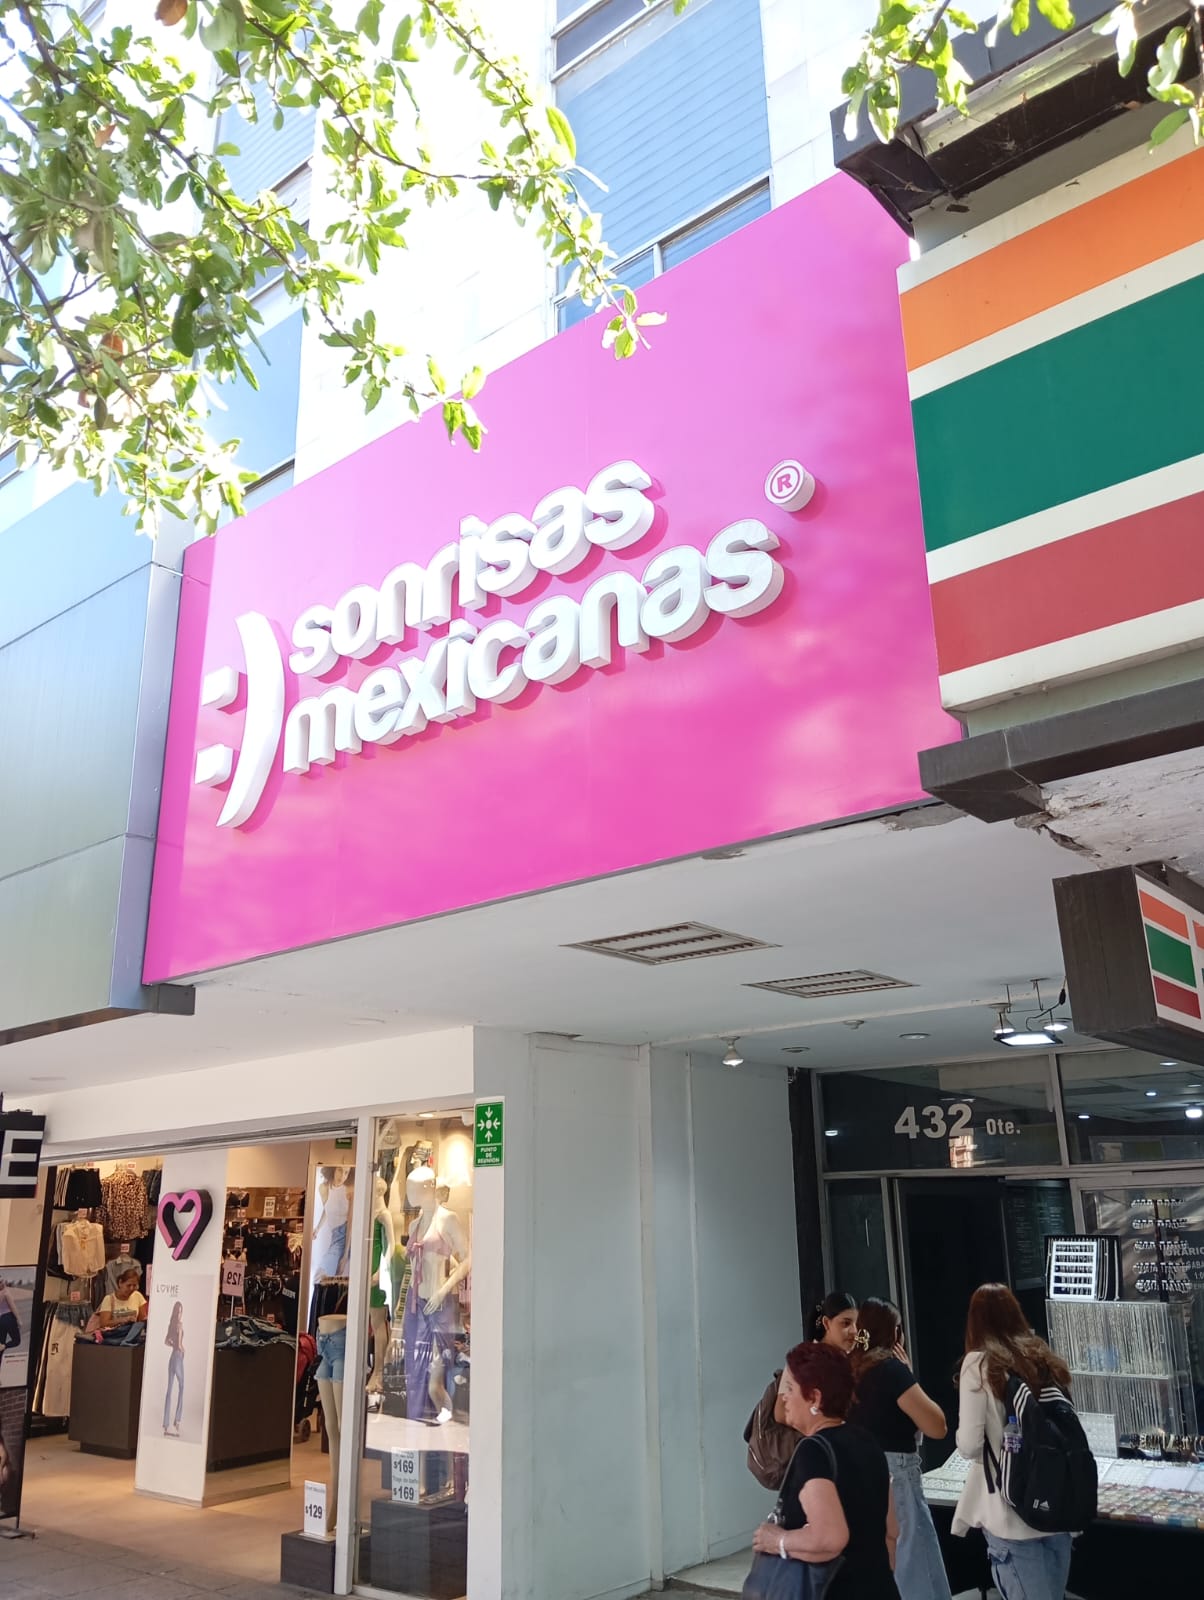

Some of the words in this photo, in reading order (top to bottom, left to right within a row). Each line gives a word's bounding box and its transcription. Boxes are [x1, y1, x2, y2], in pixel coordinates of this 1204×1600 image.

[289, 459, 655, 678] sonrisas
[283, 518, 785, 775] mexicanas
[894, 1103, 975, 1139] 432
[986, 1118, 1021, 1136] Ote.
[393, 1459, 414, 1474] $169
[393, 1486, 415, 1501] $169
[305, 1503, 323, 1519] $129
